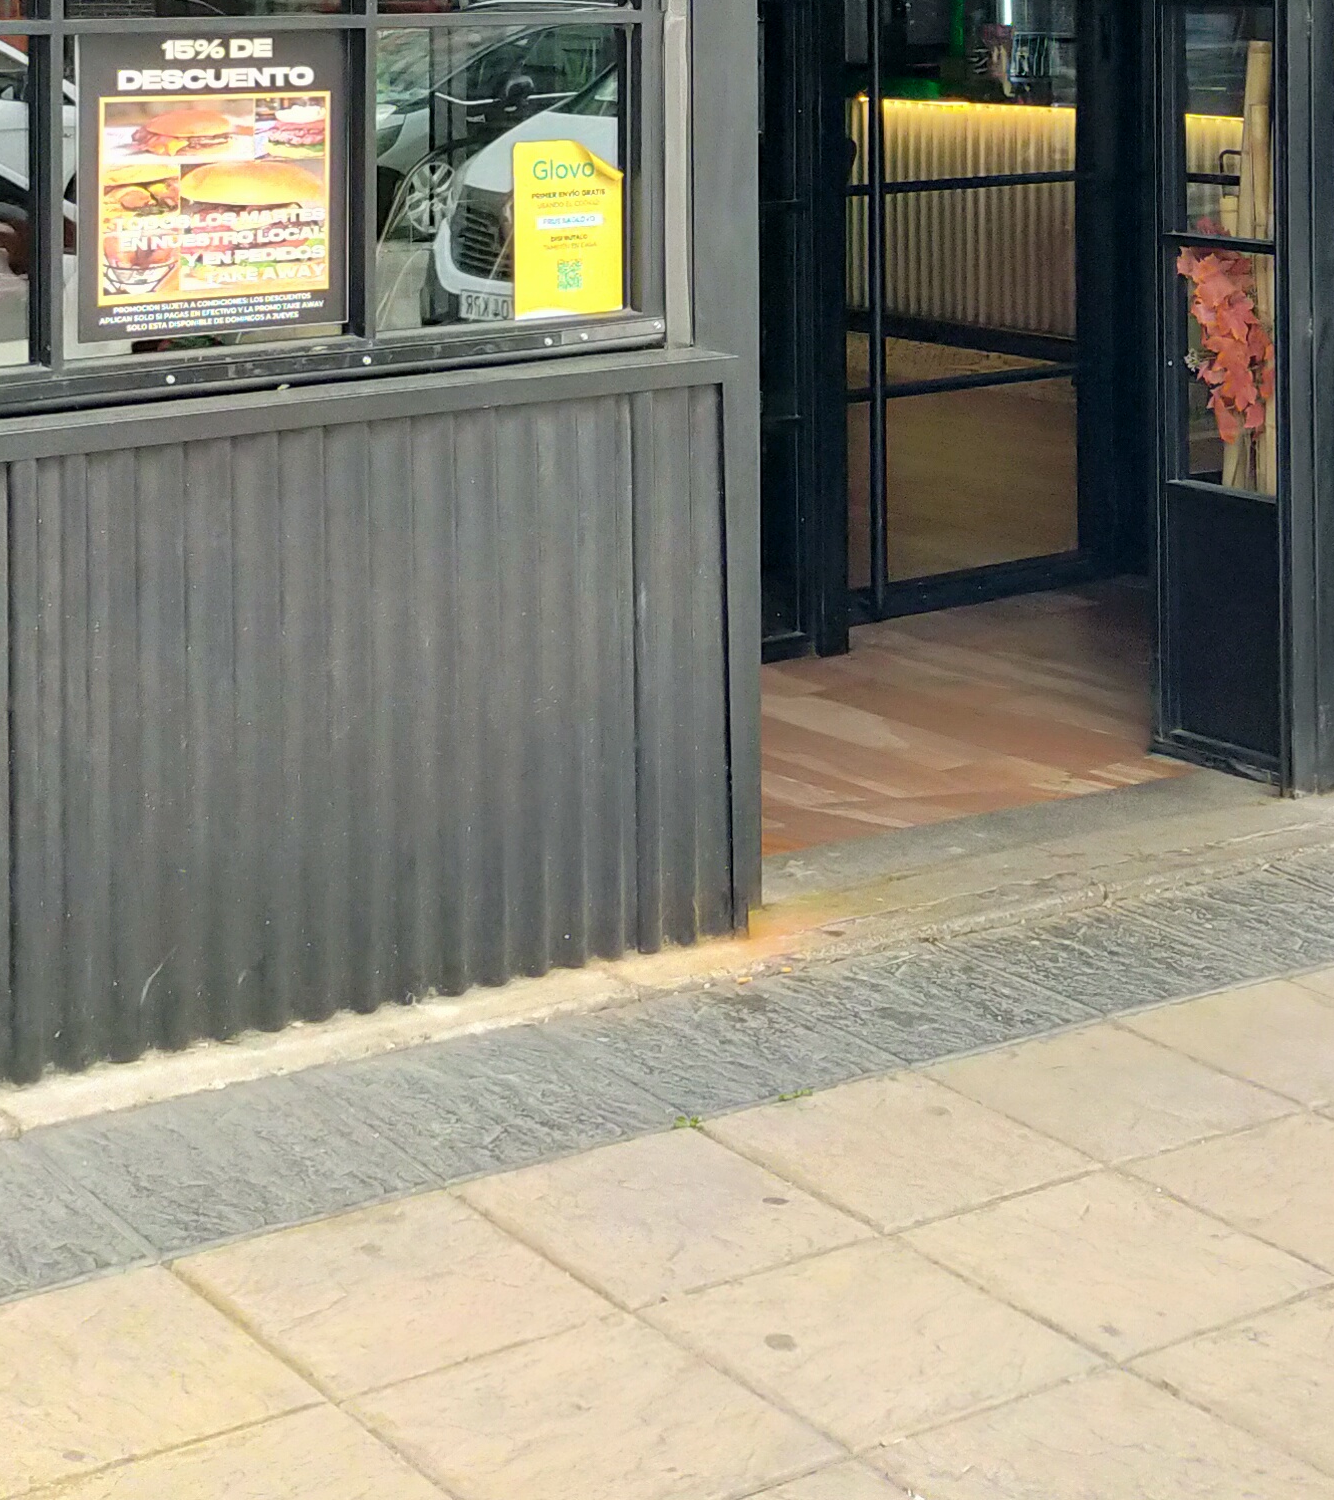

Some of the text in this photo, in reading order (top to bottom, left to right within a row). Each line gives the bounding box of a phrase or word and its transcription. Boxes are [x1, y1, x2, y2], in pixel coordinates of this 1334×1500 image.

[161, 38, 273, 60] 15% DE
[117, 66, 315, 90] DESCUENTO
[533, 159, 595, 180] Glovo
[194, 212, 237, 228] LOS
[241, 208, 325, 224] MARTES
[120, 226, 325, 251] EN NUESTRO LOCAL
[182, 245, 325, 267] Y EN PEDIDOS
[205, 263, 325, 284] TAKE AWAY
[250, 295, 264, 303] LOS
[134, 314, 154, 322] SOLO
[164, 311, 189, 320] PAGAS
[190, 309, 201, 317] EN
[202, 307, 236, 317] EFECTIVO
[244, 305, 254, 313] LA
[255, 303, 281, 312] PROMO
[282, 301, 300, 310] TAKE
[301, 300, 325, 308] AWAY
[126, 323, 147, 332] SOLO
[169, 317, 212, 328] DISPONIBLE
[214, 316, 224, 324] DE
